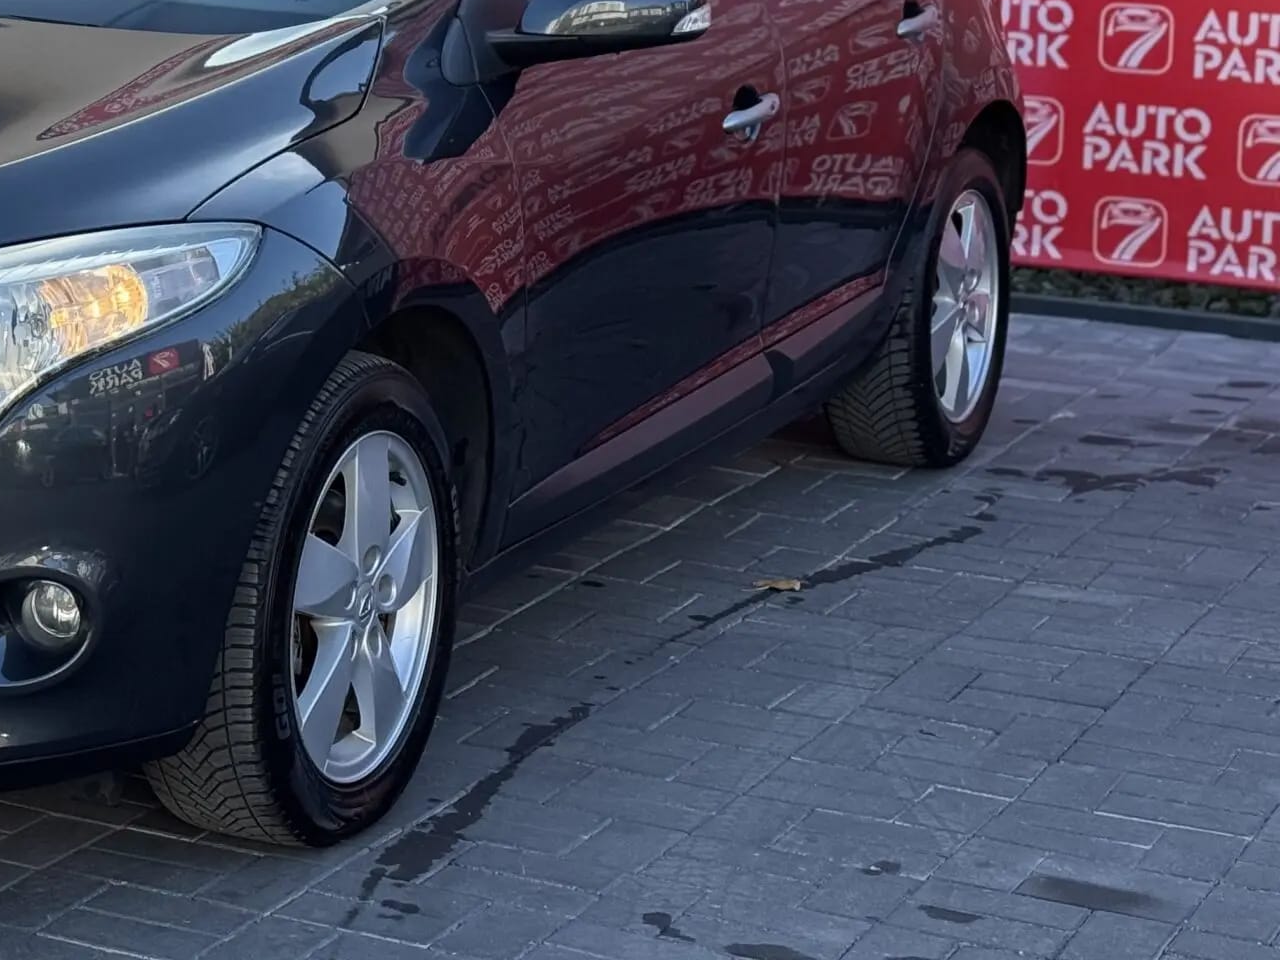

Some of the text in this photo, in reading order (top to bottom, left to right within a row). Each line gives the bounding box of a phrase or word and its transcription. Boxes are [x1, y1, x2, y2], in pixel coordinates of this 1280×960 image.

[1194, 9, 1280, 48] AUT
[1193, 44, 1280, 85] PAR
[1083, 102, 1211, 143] AUTO
[1083, 134, 1206, 180] PARK
[1188, 205, 1280, 245] AUT
